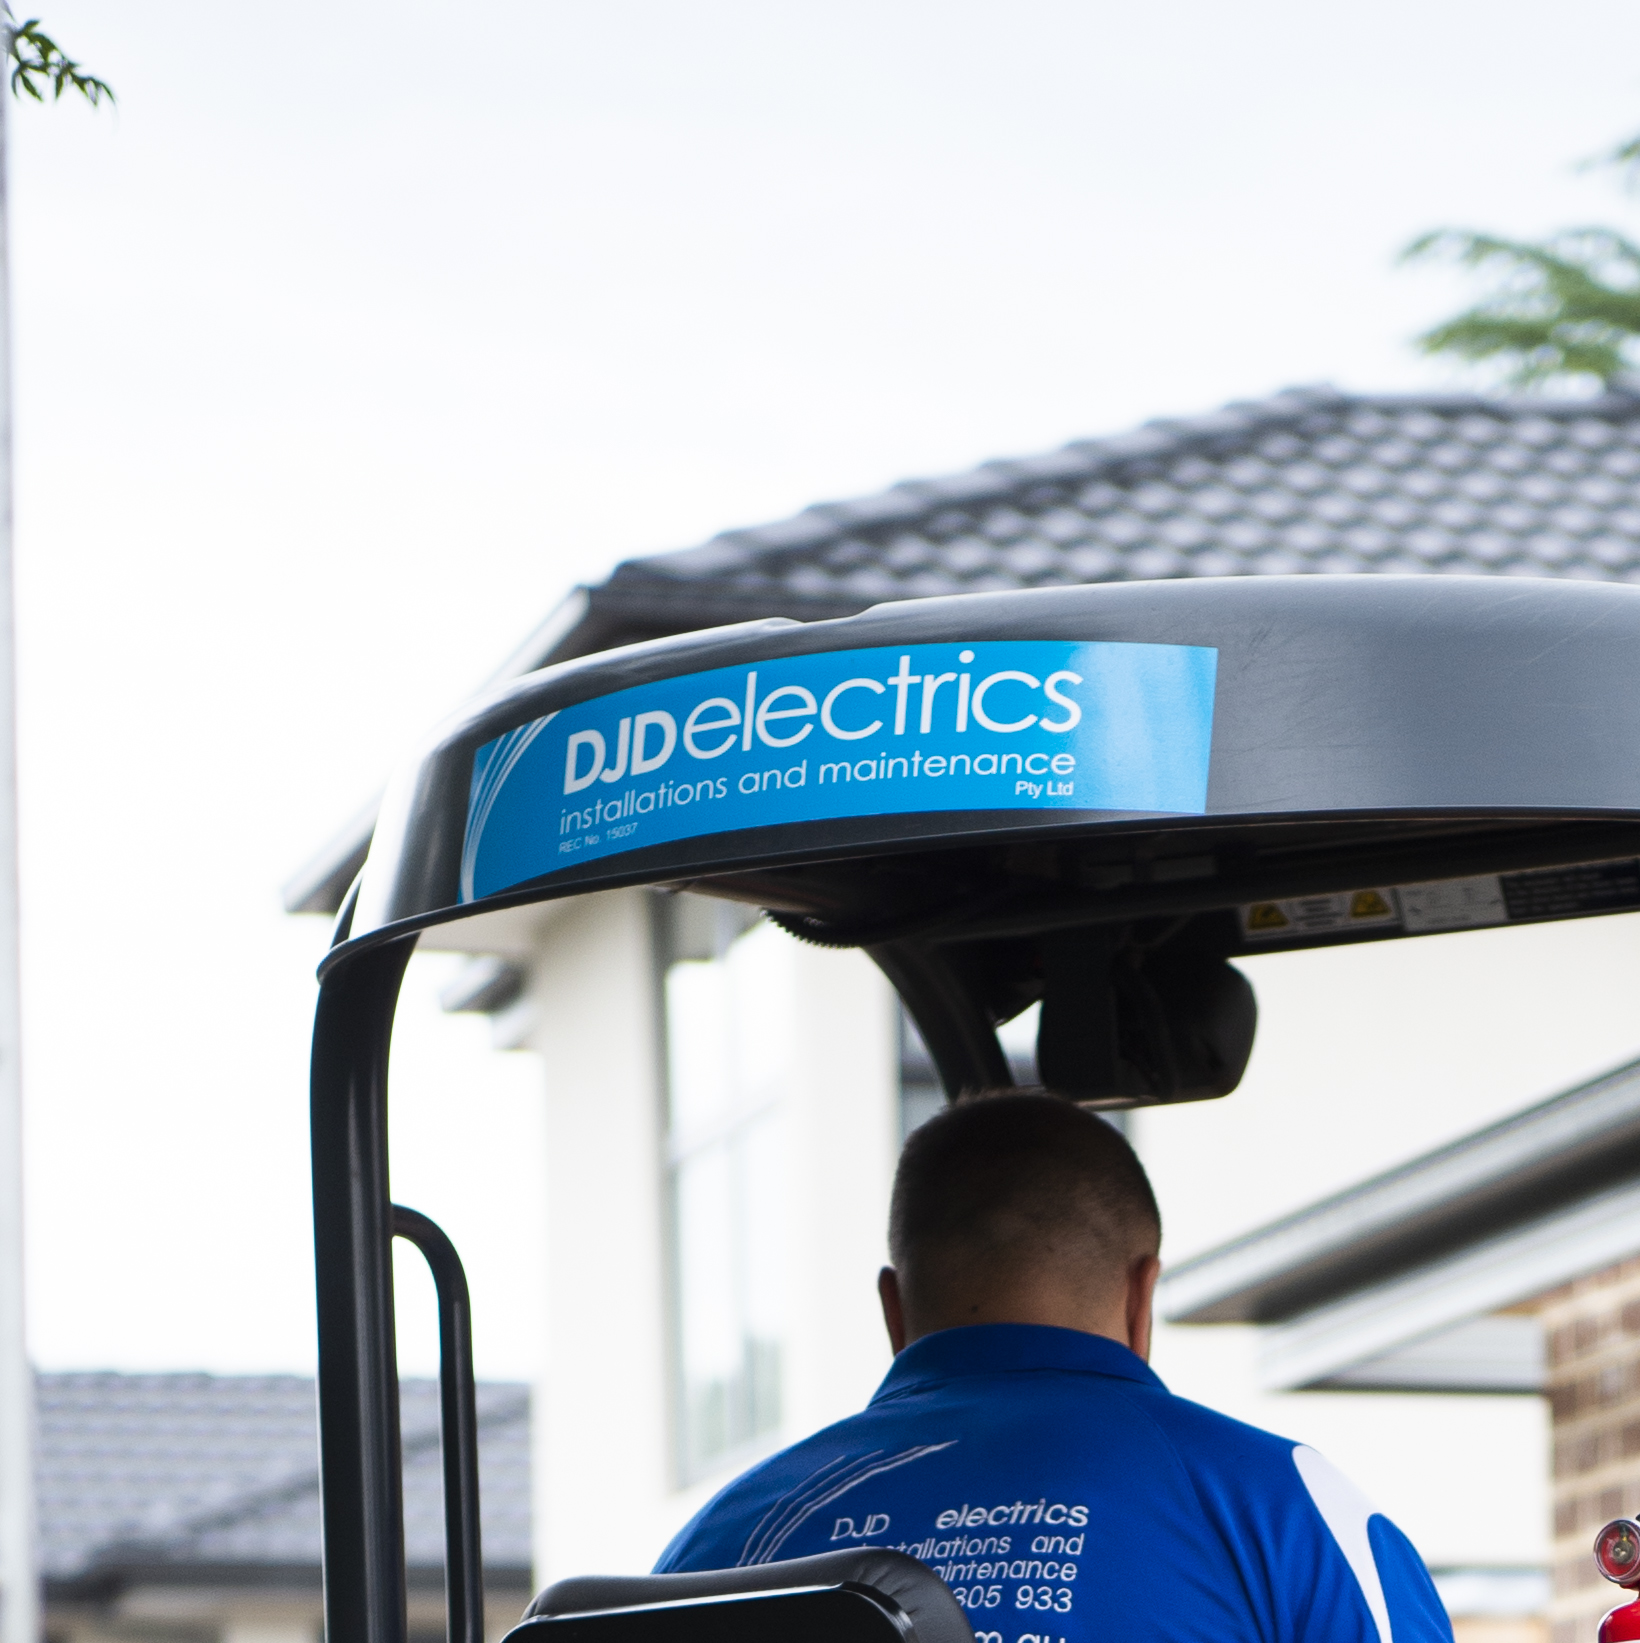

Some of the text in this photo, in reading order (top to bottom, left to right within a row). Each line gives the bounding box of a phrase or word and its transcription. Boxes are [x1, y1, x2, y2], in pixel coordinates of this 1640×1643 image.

[559, 750, 1076, 836] installations and maintenance
[1015, 779, 1074, 798] Pty Ltd
[558, 836, 583, 856] REC
[606, 821, 639, 841] 15037
[829, 1498, 1090, 1541] DJD electrics
[1031, 1532, 1085, 1556] and
[1014, 1585, 1073, 1613] 933
